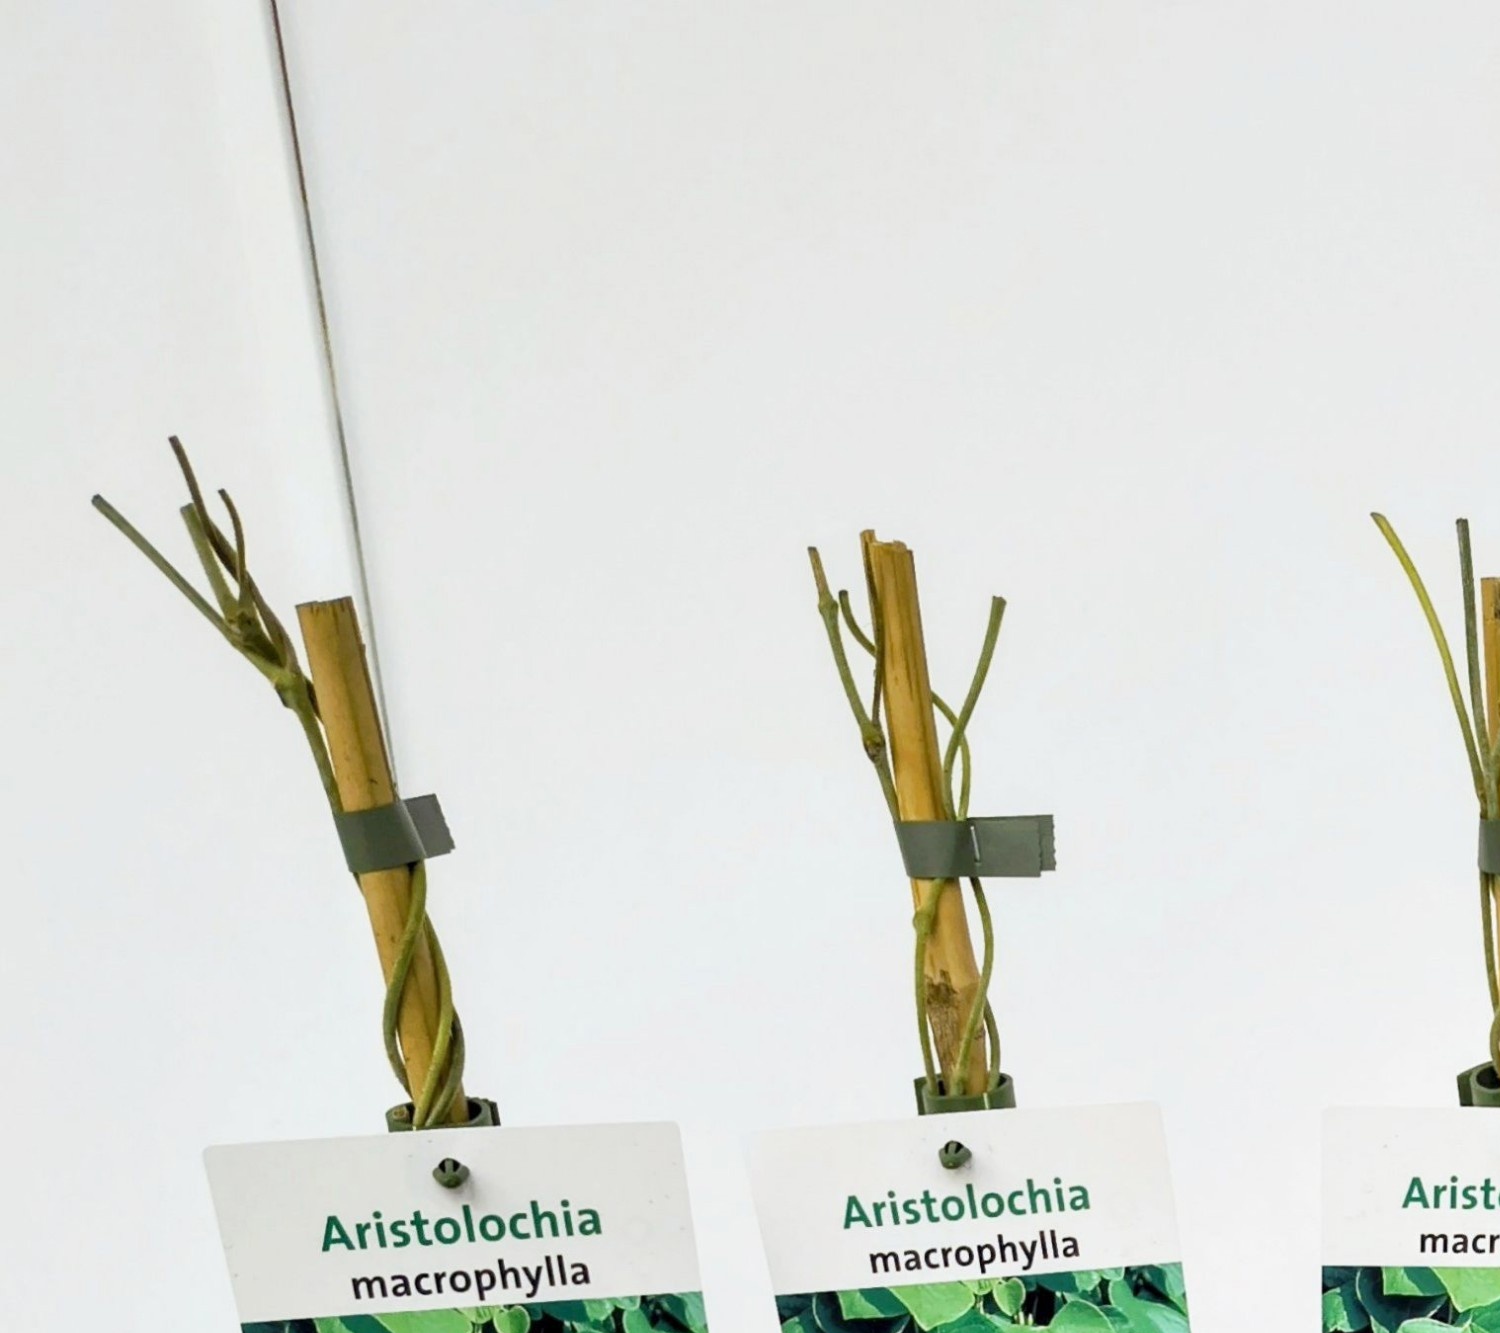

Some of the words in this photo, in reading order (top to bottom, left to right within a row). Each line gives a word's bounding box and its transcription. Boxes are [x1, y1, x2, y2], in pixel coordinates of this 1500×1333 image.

[321, 1199, 603, 1253] Aristolochia
[843, 1177, 1091, 1230] Aristolochia
[869, 1229, 1080, 1274] macrophylla
[351, 1254, 591, 1300] macrophylla
